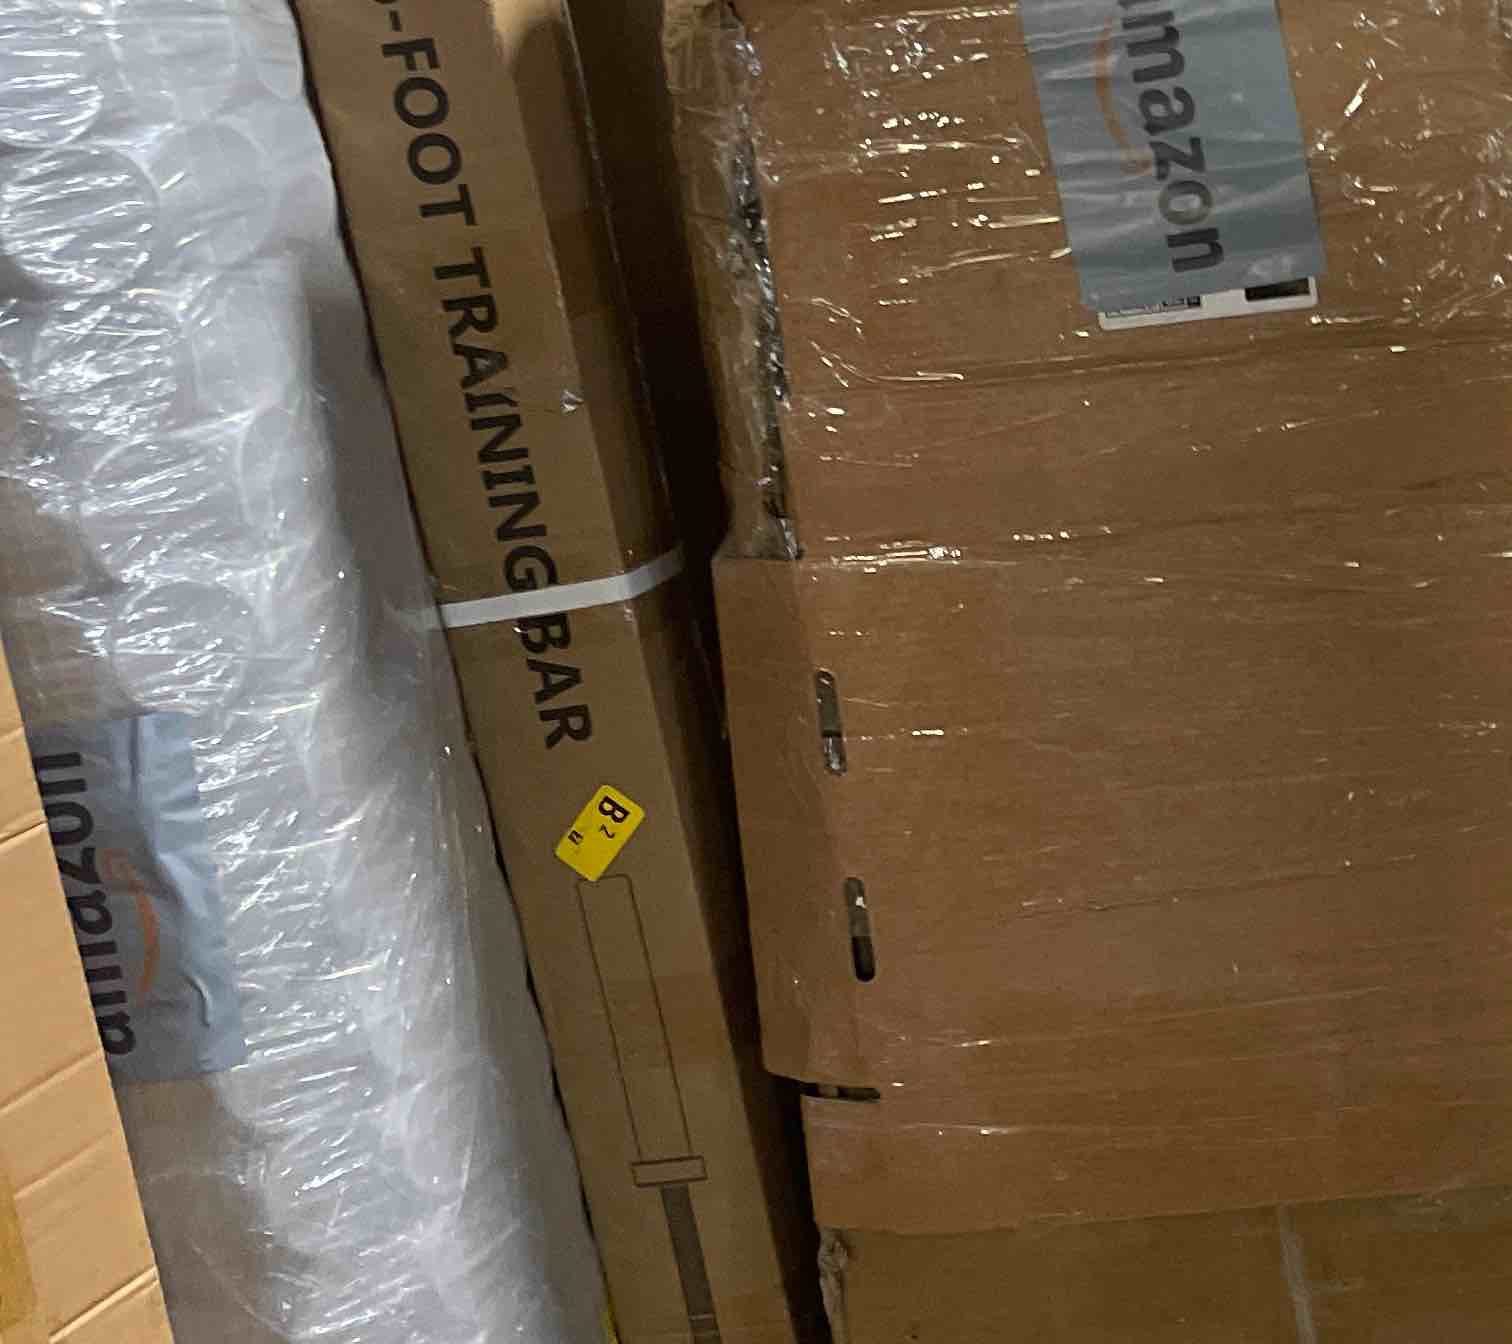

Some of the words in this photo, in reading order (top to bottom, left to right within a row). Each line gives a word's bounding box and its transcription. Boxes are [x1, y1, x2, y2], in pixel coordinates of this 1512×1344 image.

[433, 246, 559, 592] TRAINING
[519, 613, 593, 748] BAR
[33, 750, 138, 1056] amazon
